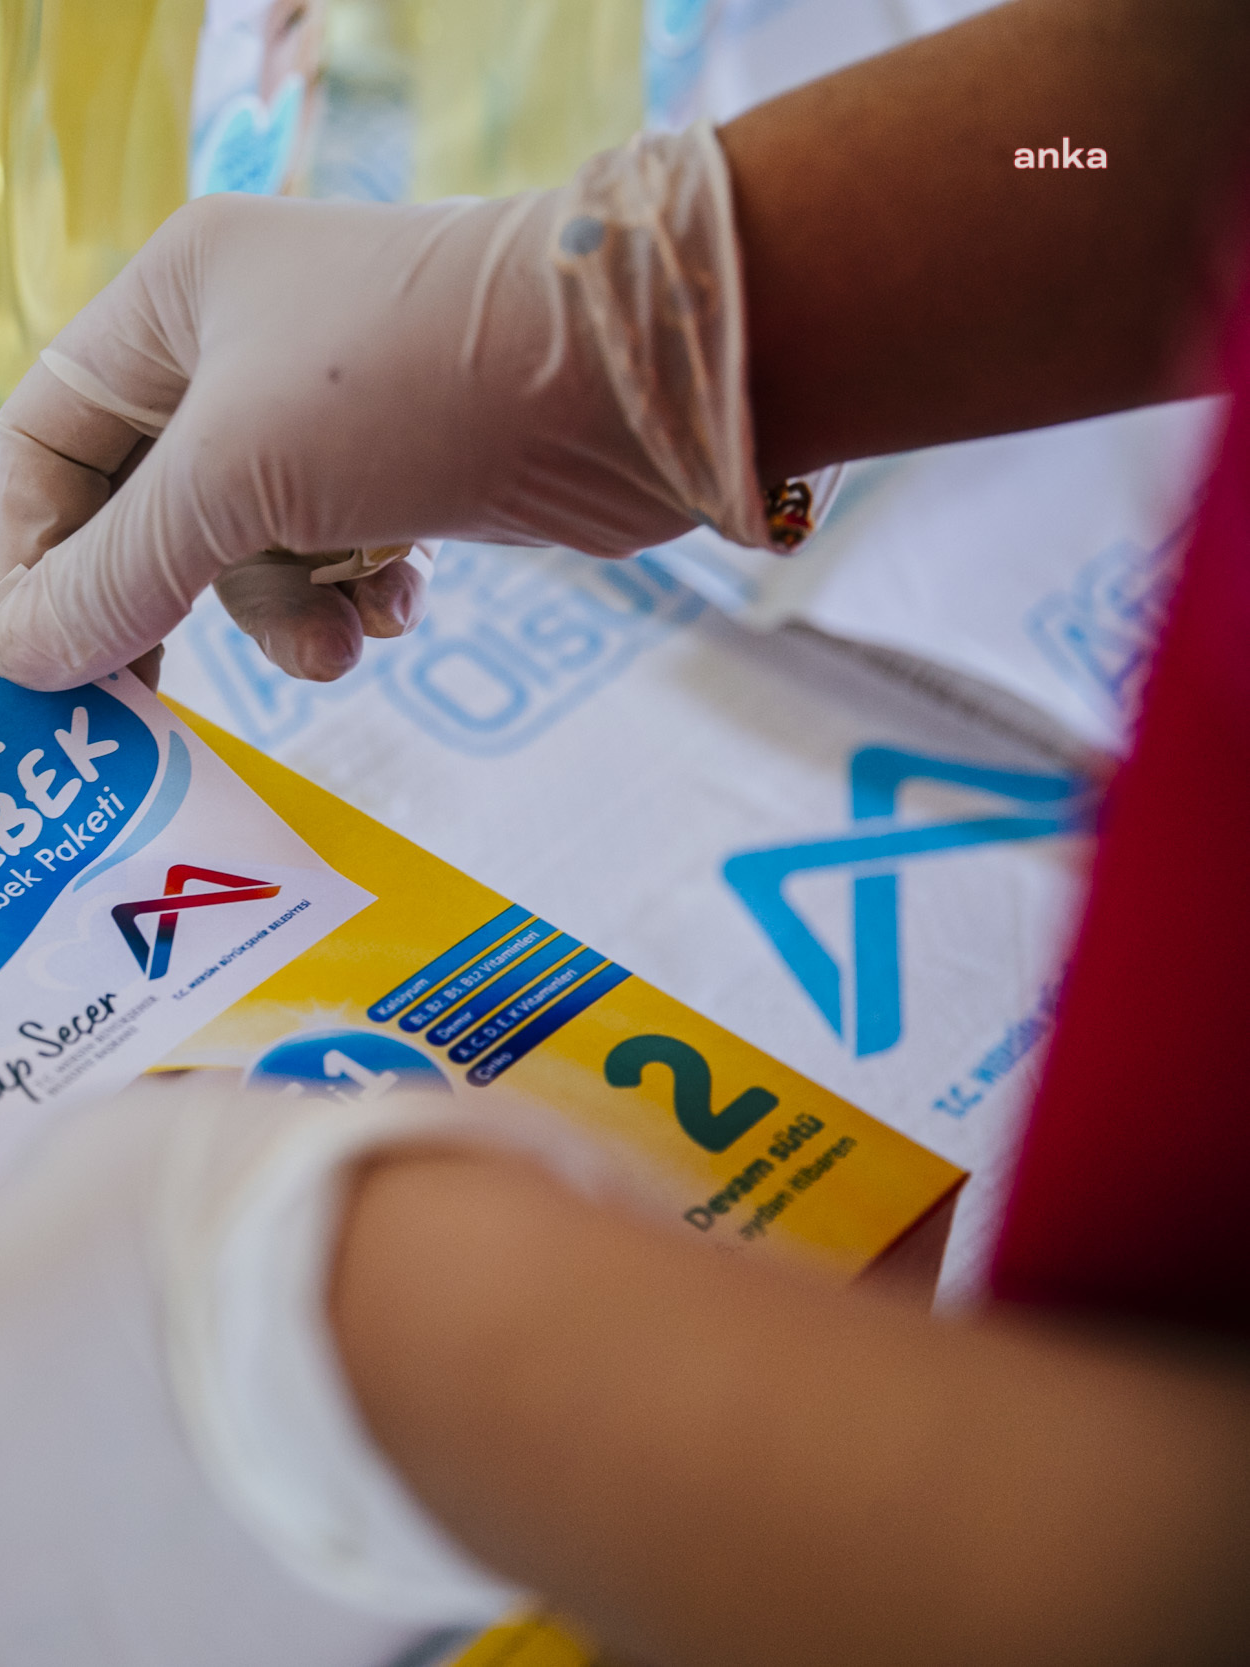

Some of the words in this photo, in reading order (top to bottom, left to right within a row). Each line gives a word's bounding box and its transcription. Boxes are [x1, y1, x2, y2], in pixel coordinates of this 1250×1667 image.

[34, 785, 127, 874] Paketi
[267, 898, 312, 932] BELEDİYESİ
[478, 929, 541, 974] Vitaminleri
[376, 977, 430, 1017] Kalsiyum
[517, 967, 579, 1013] Vitaminleri
[435, 1010, 474, 1041] Demir
[604, 1032, 780, 1155] 2
[683, 1157, 776, 1233] Devam
[767, 1112, 826, 1162] sütü
